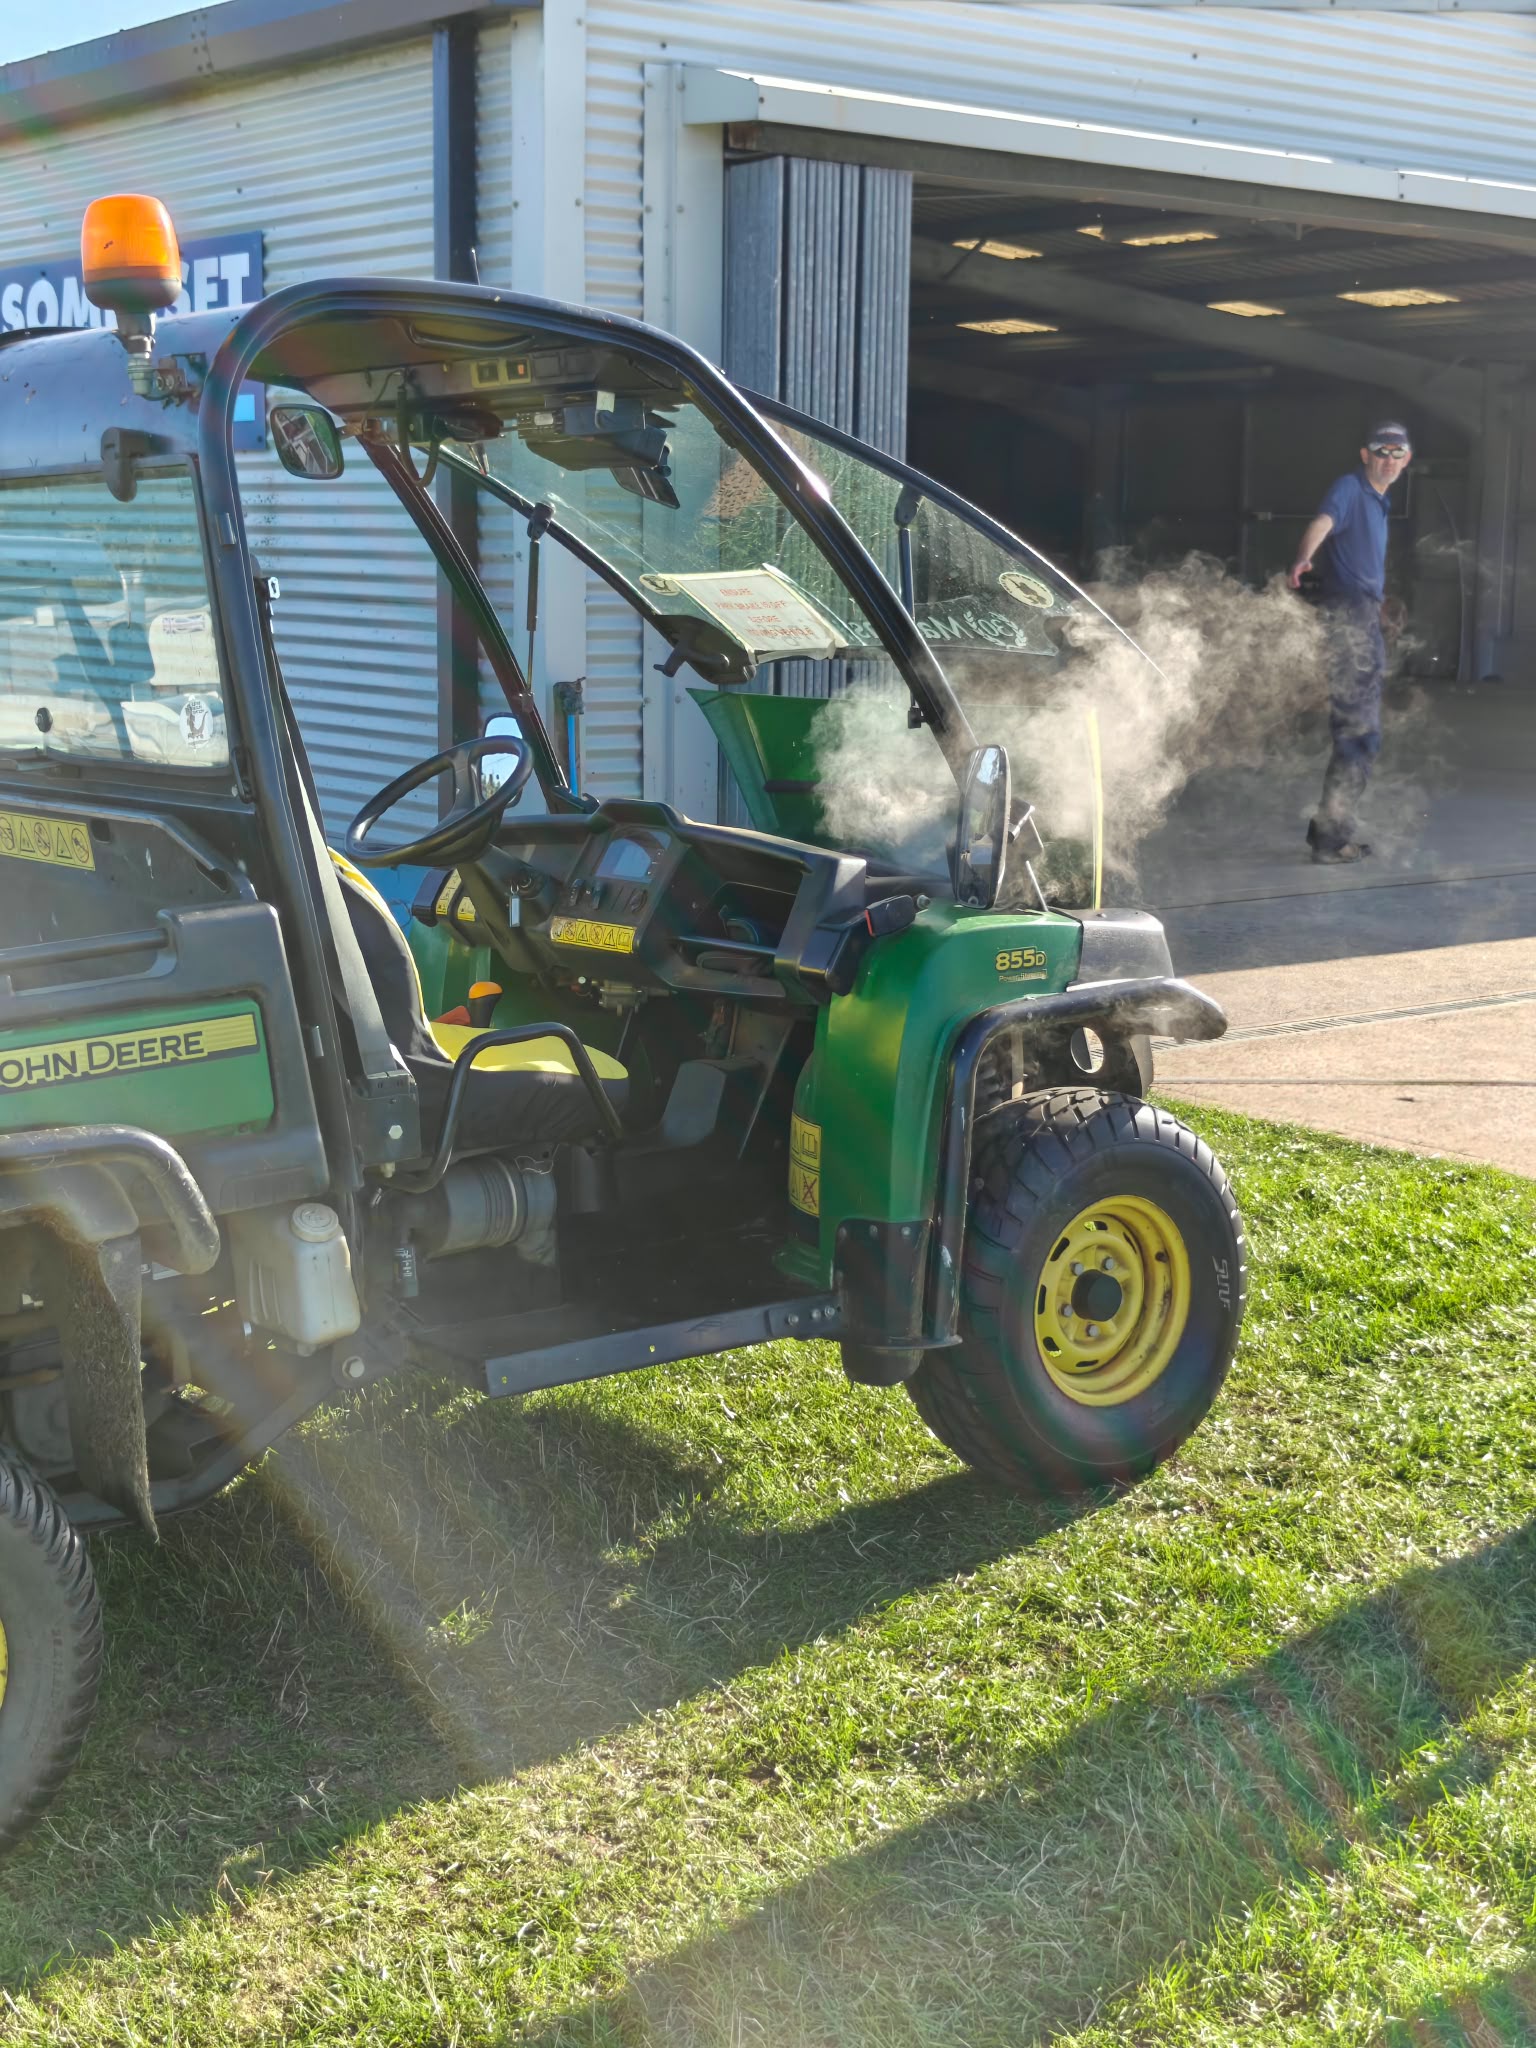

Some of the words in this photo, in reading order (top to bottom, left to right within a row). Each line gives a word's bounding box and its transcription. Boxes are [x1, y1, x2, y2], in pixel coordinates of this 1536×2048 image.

[1, 252, 250, 332] SOMSET
[995, 948, 1045, 971] 855D
[87, 1031, 204, 1071] DEERE
